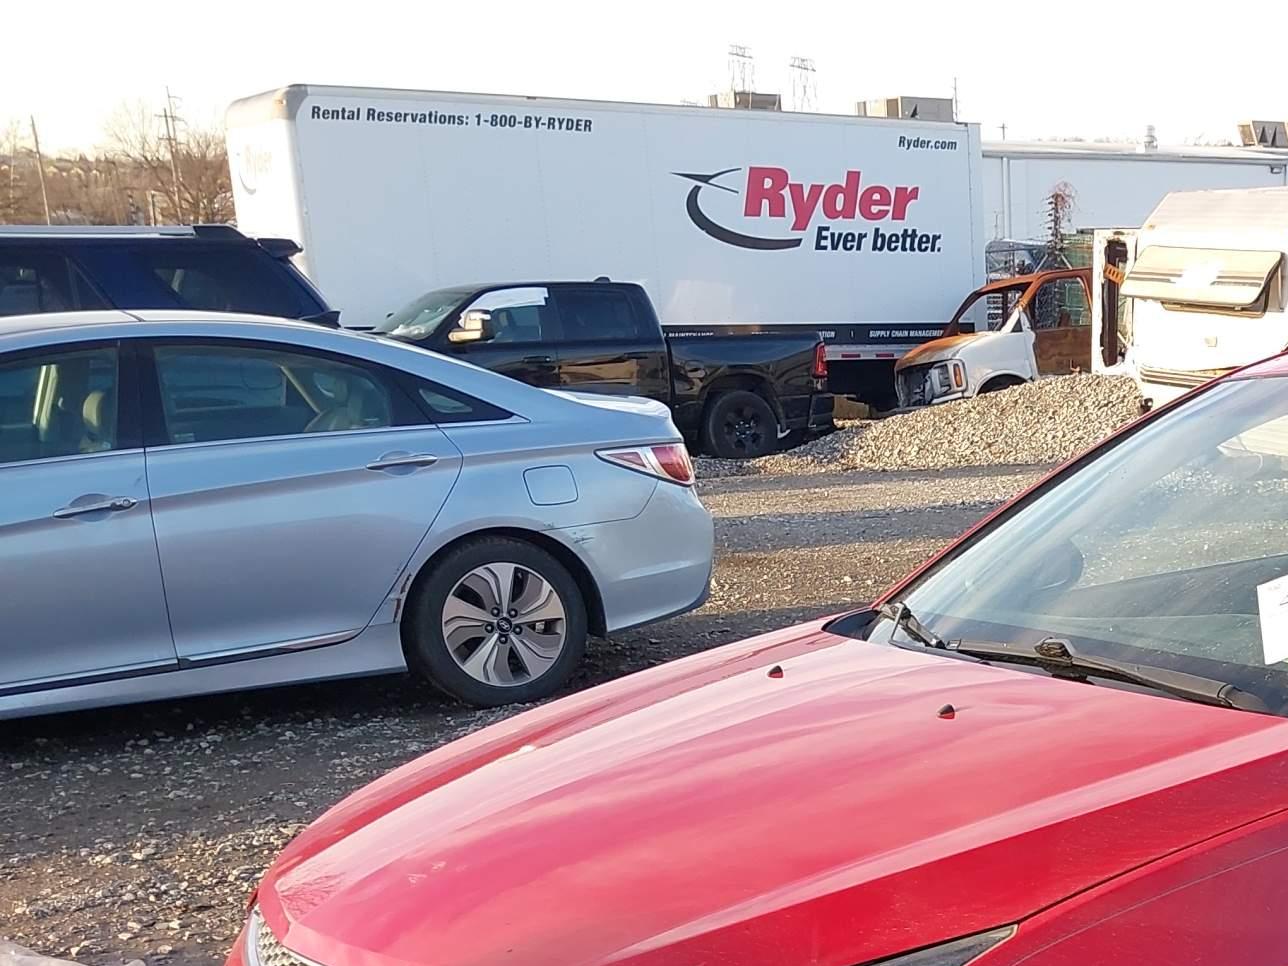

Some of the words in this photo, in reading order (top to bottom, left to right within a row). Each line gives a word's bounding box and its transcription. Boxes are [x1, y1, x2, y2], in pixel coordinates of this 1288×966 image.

[310, 105, 361, 121] Rental
[366, 108, 470, 126] Reservations:
[474, 113, 593, 132] 1-800-BY-RYDER
[898, 135, 958, 151] Ryder.com
[743, 166, 920, 232] Ryder
[814, 226, 866, 252] Ever
[871, 228, 942, 253] better.
[869, 330, 890, 338] SUPPLY
